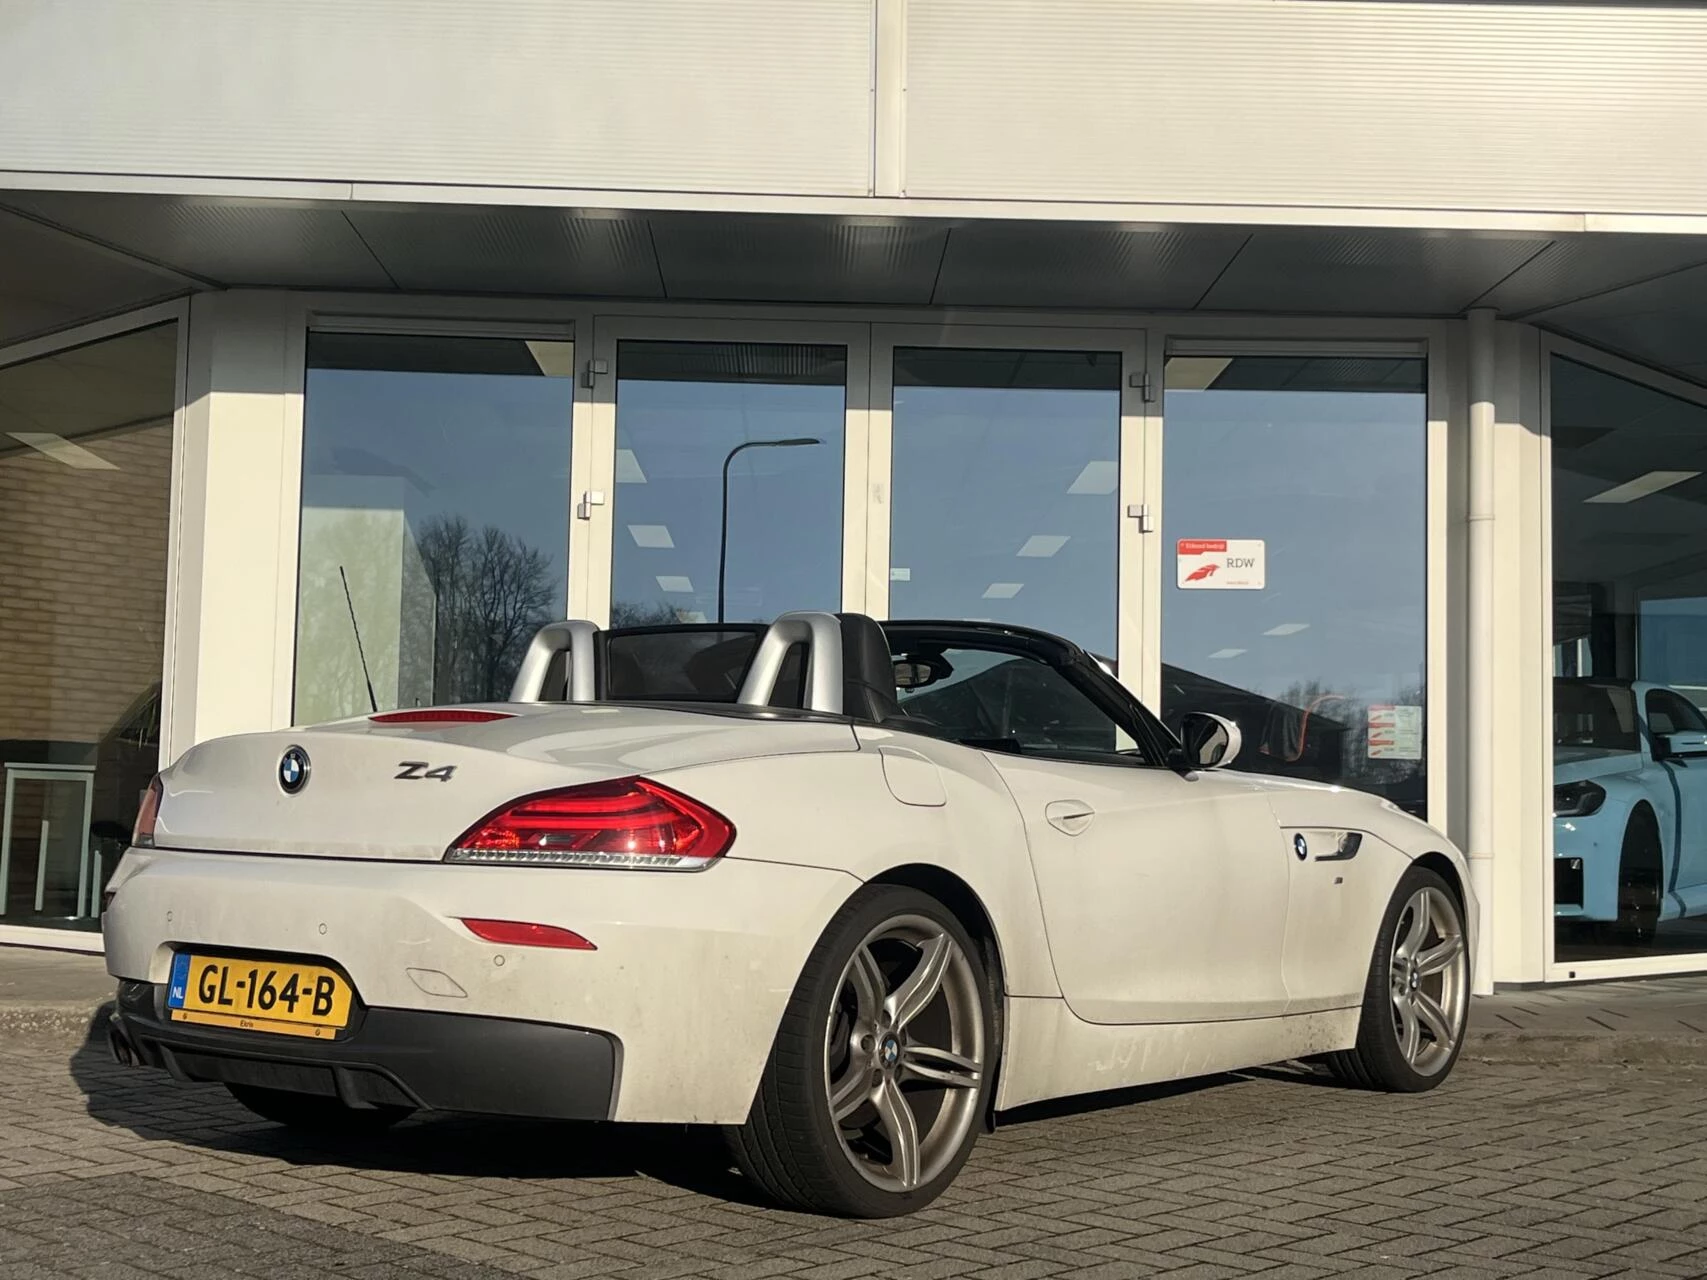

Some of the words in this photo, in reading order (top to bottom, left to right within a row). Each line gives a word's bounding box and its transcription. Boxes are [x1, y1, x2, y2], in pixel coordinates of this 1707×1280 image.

[1226, 558, 1255, 568] RDW
[394, 761, 457, 782] Z4
[172, 987, 183, 1000] NL
[199, 965, 335, 1016] GL-164-B
